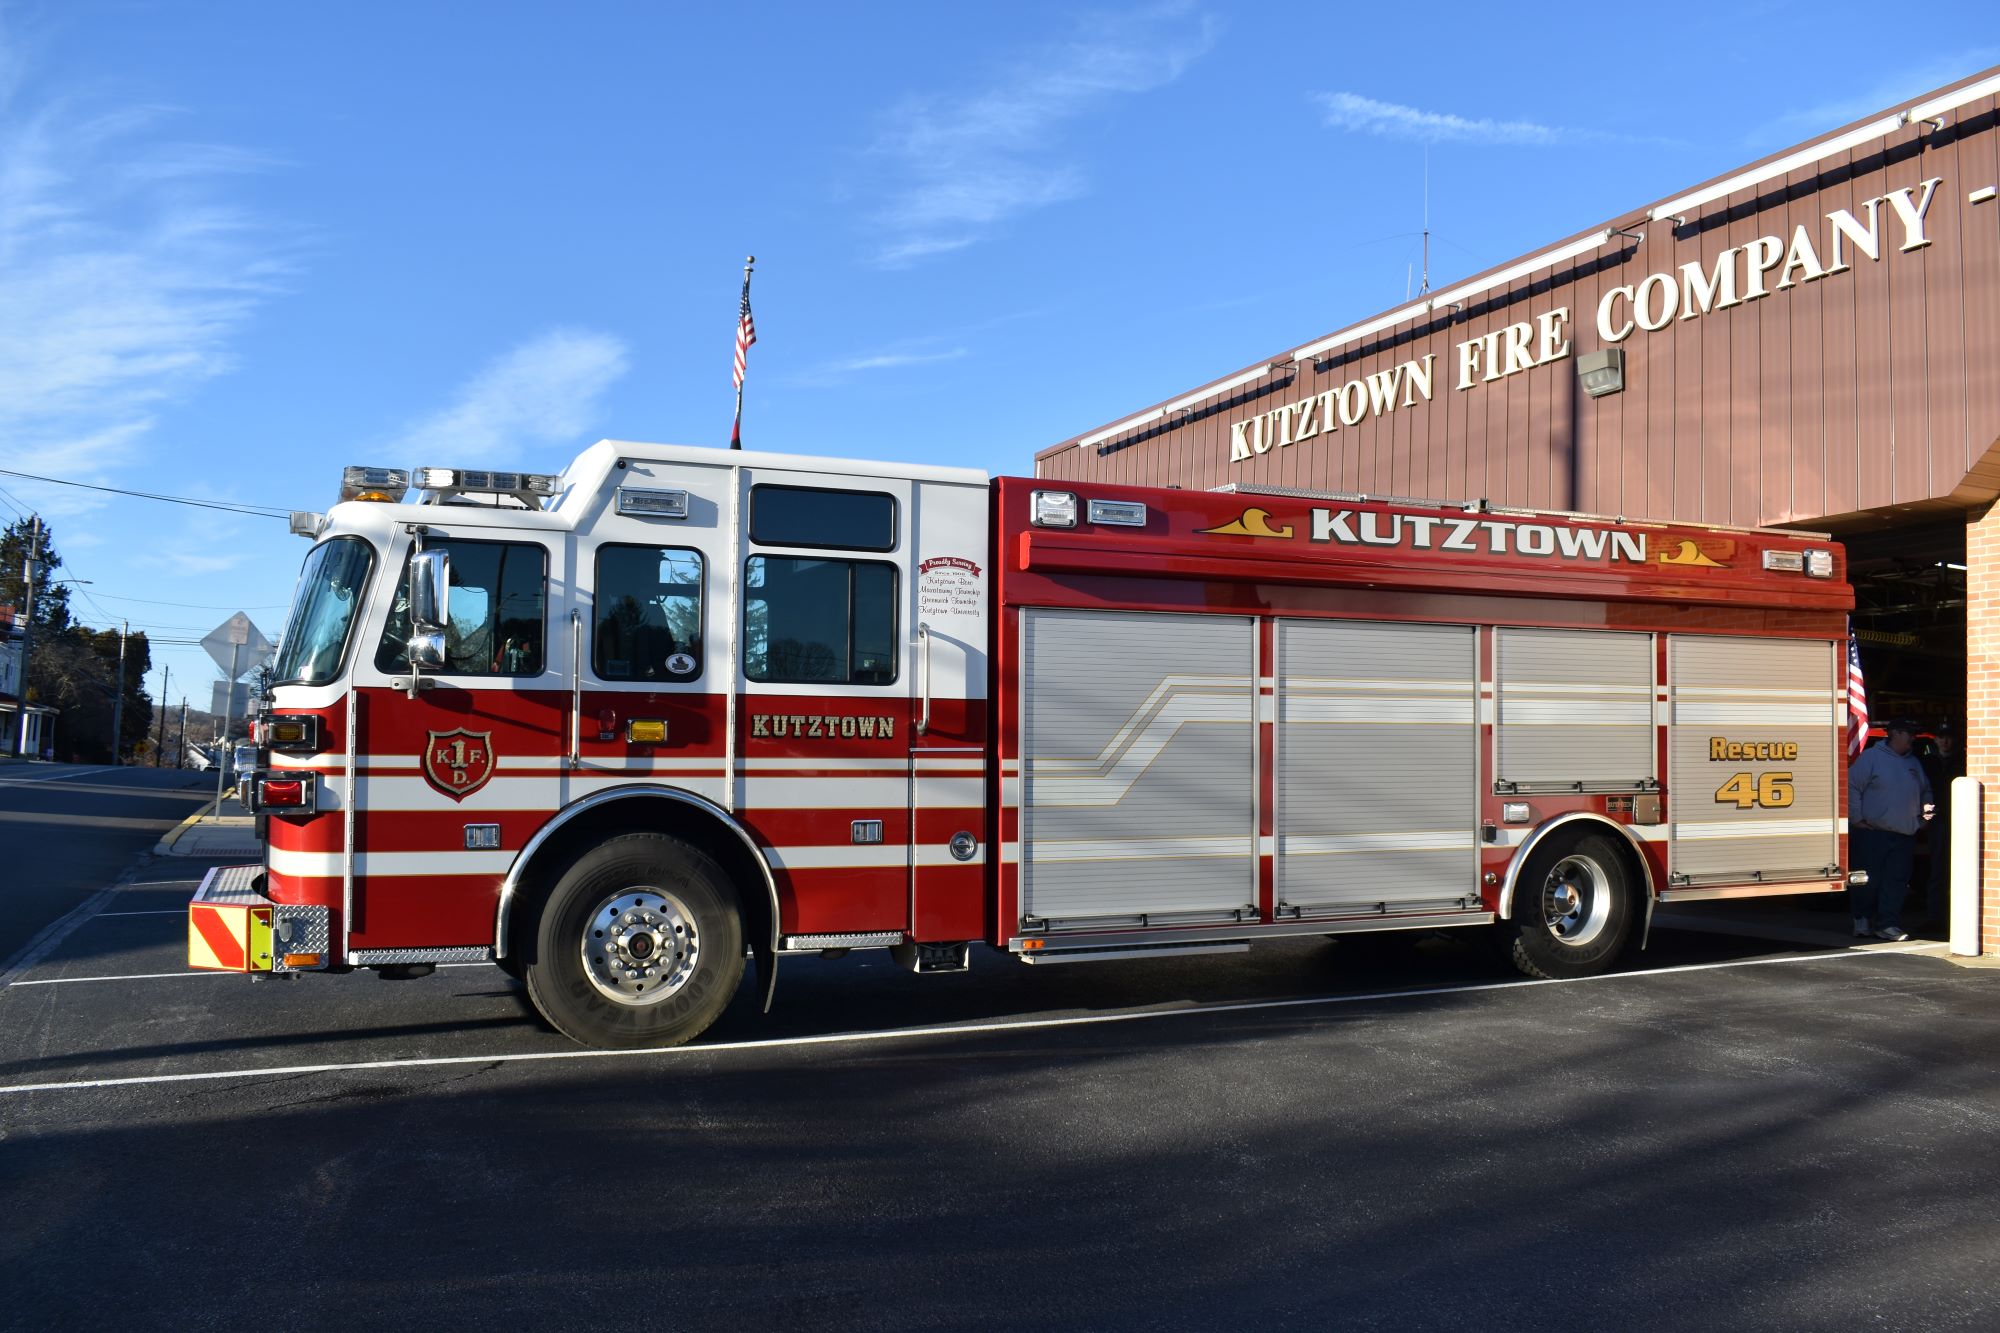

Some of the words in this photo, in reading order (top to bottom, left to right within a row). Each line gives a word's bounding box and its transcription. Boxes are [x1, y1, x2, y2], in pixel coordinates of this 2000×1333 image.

[1230, 353, 1436, 463] KUTZTOWN
[1455, 306, 1571, 391] FIRE
[1597, 177, 1943, 342] COMPANY
[1311, 508, 1646, 561] KUTZTOWN
[929, 558, 950, 567] Proudly
[951, 558, 973, 570] Serving
[951, 596, 977, 607] Township
[955, 587, 981, 598] Township
[950, 607, 980, 618] University
[752, 714, 895, 738] KUTZTOWN
[450, 739, 468, 768] 1
[1709, 736, 1798, 761] Rescue
[453, 770, 471, 785] D.
[1715, 772, 1795, 810] 46
